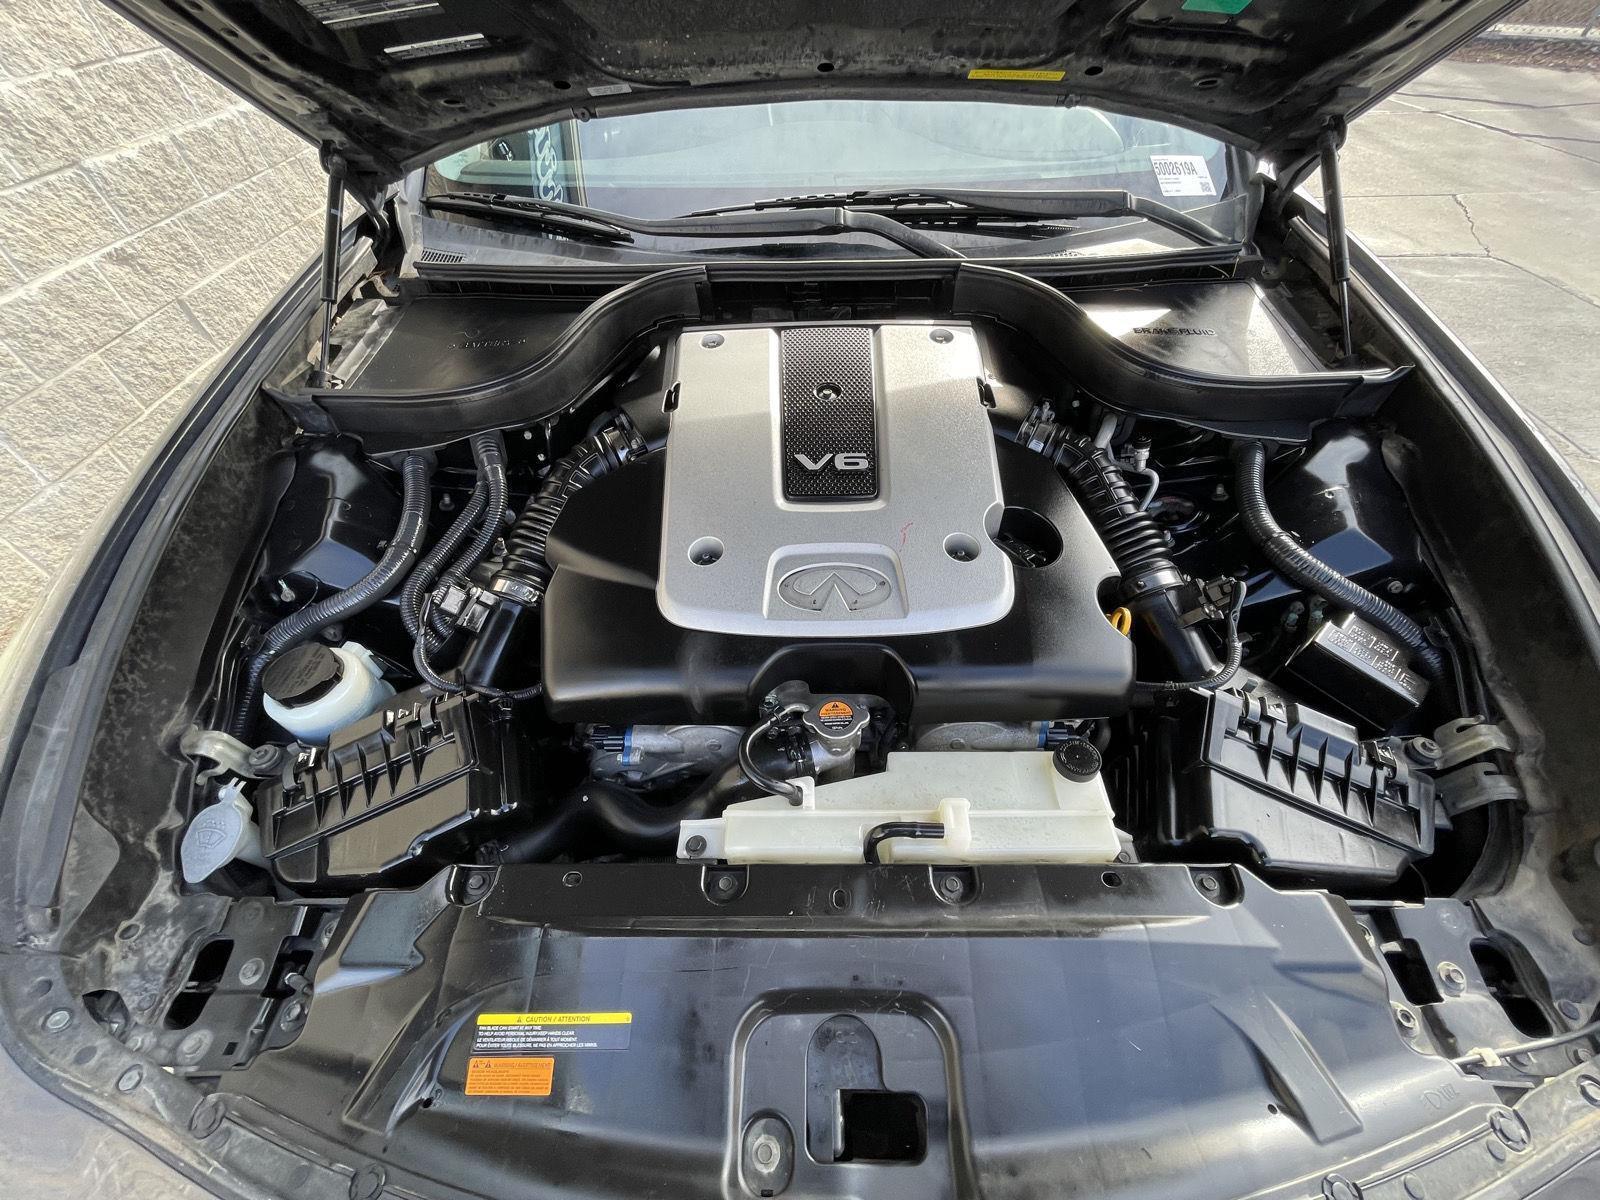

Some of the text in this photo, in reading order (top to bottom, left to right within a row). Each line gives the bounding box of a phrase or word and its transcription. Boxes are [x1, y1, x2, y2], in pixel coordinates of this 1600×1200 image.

[1154, 161, 1198, 175] 5002619A
[794, 453, 869, 470] V6
[558, 1015, 591, 1023] ATTENTION
